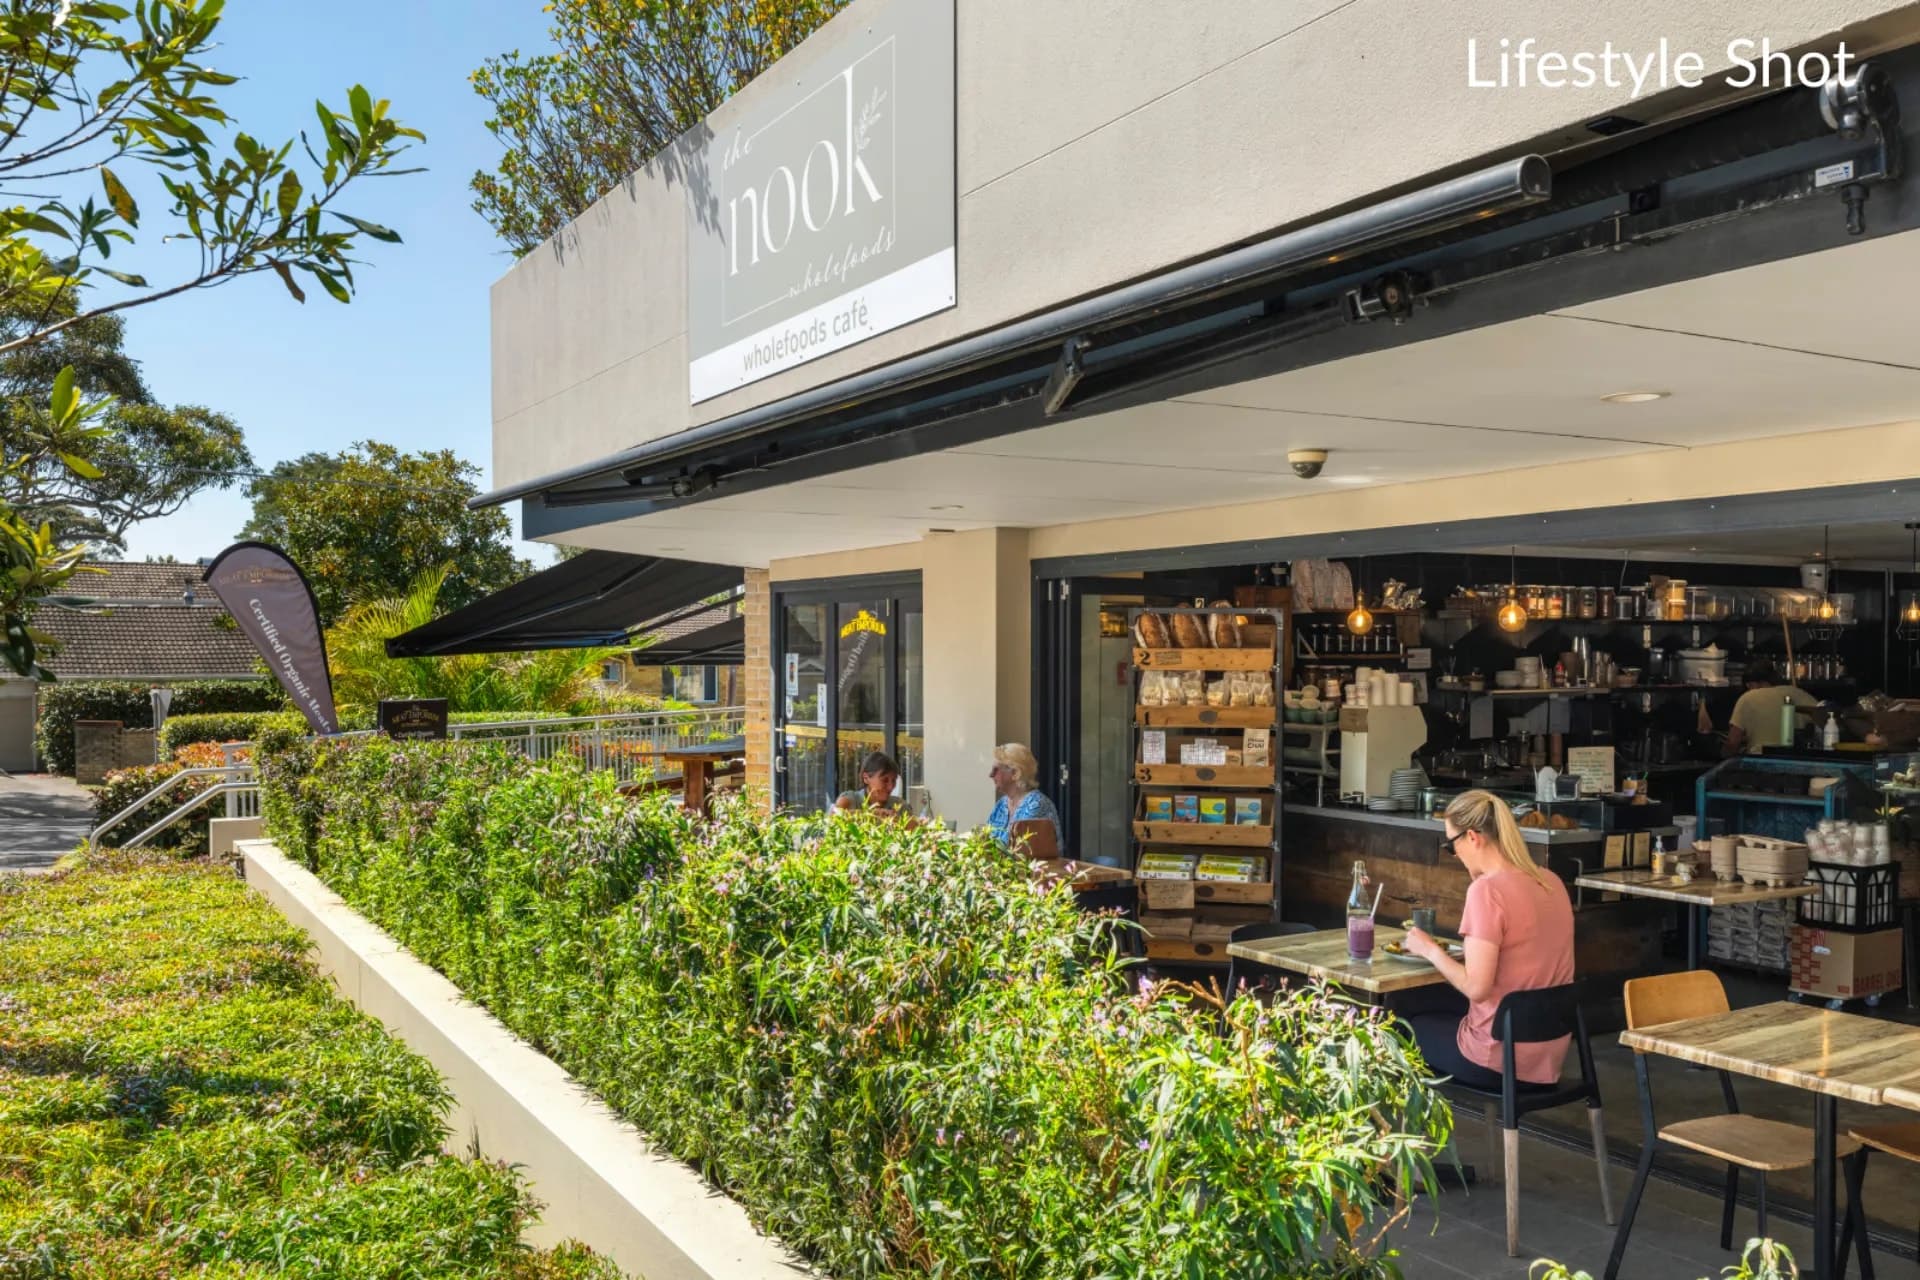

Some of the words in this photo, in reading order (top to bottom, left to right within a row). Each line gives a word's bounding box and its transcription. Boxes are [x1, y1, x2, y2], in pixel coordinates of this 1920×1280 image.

[721, 129, 753, 172] the
[729, 66, 883, 276] nook
[787, 225, 895, 299] wholefoods
[742, 315, 828, 373] wholefoods
[832, 297, 869, 338] café
[249, 598, 287, 654] Certified
[280, 652, 310, 700] Organic
[1139, 650, 1152, 665] 2
[1139, 767, 1153, 783] 3
